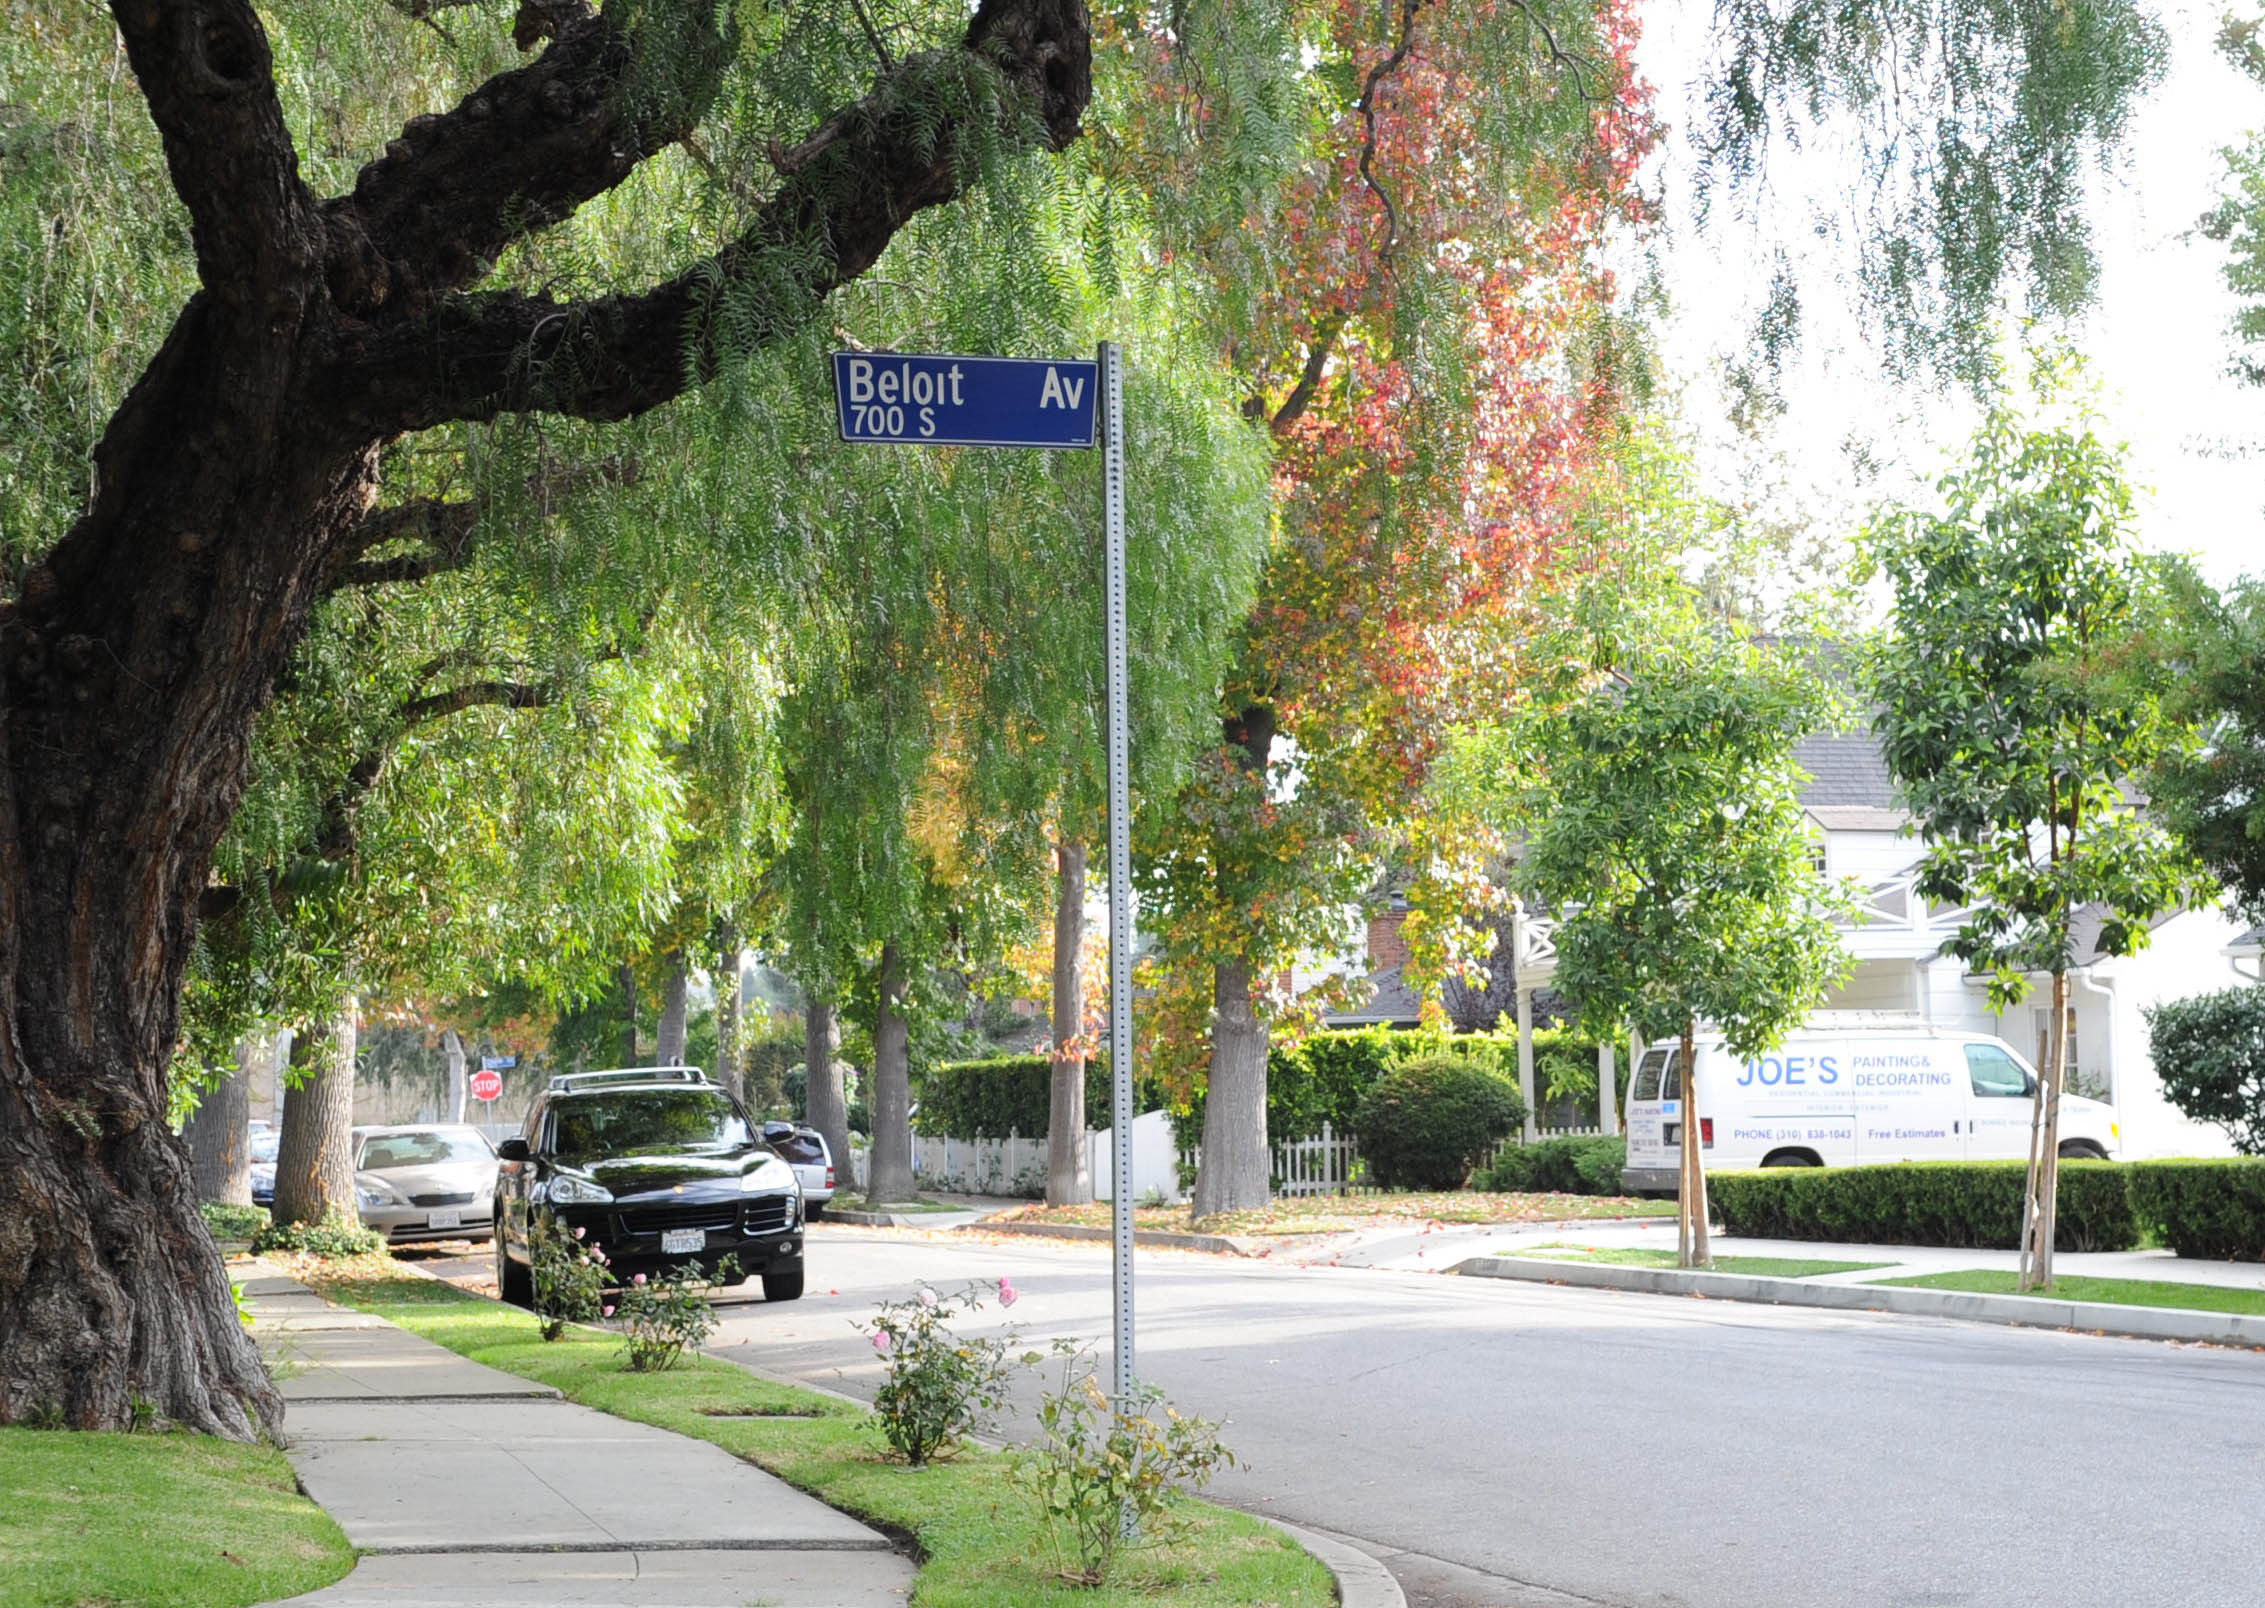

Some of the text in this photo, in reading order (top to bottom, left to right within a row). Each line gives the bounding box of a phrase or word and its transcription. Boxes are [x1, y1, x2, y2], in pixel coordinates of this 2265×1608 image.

[850, 359, 1085, 410] Beloit Av
[850, 405, 936, 437] 700 S
[1736, 1056, 1839, 1087] JOE'S
[473, 1079, 499, 1093] STOP
[1855, 1072, 1952, 1087] DECORATING
[1733, 1129, 1774, 1140] PHONE
[1868, 1128, 1947, 1139] Free Estimates
